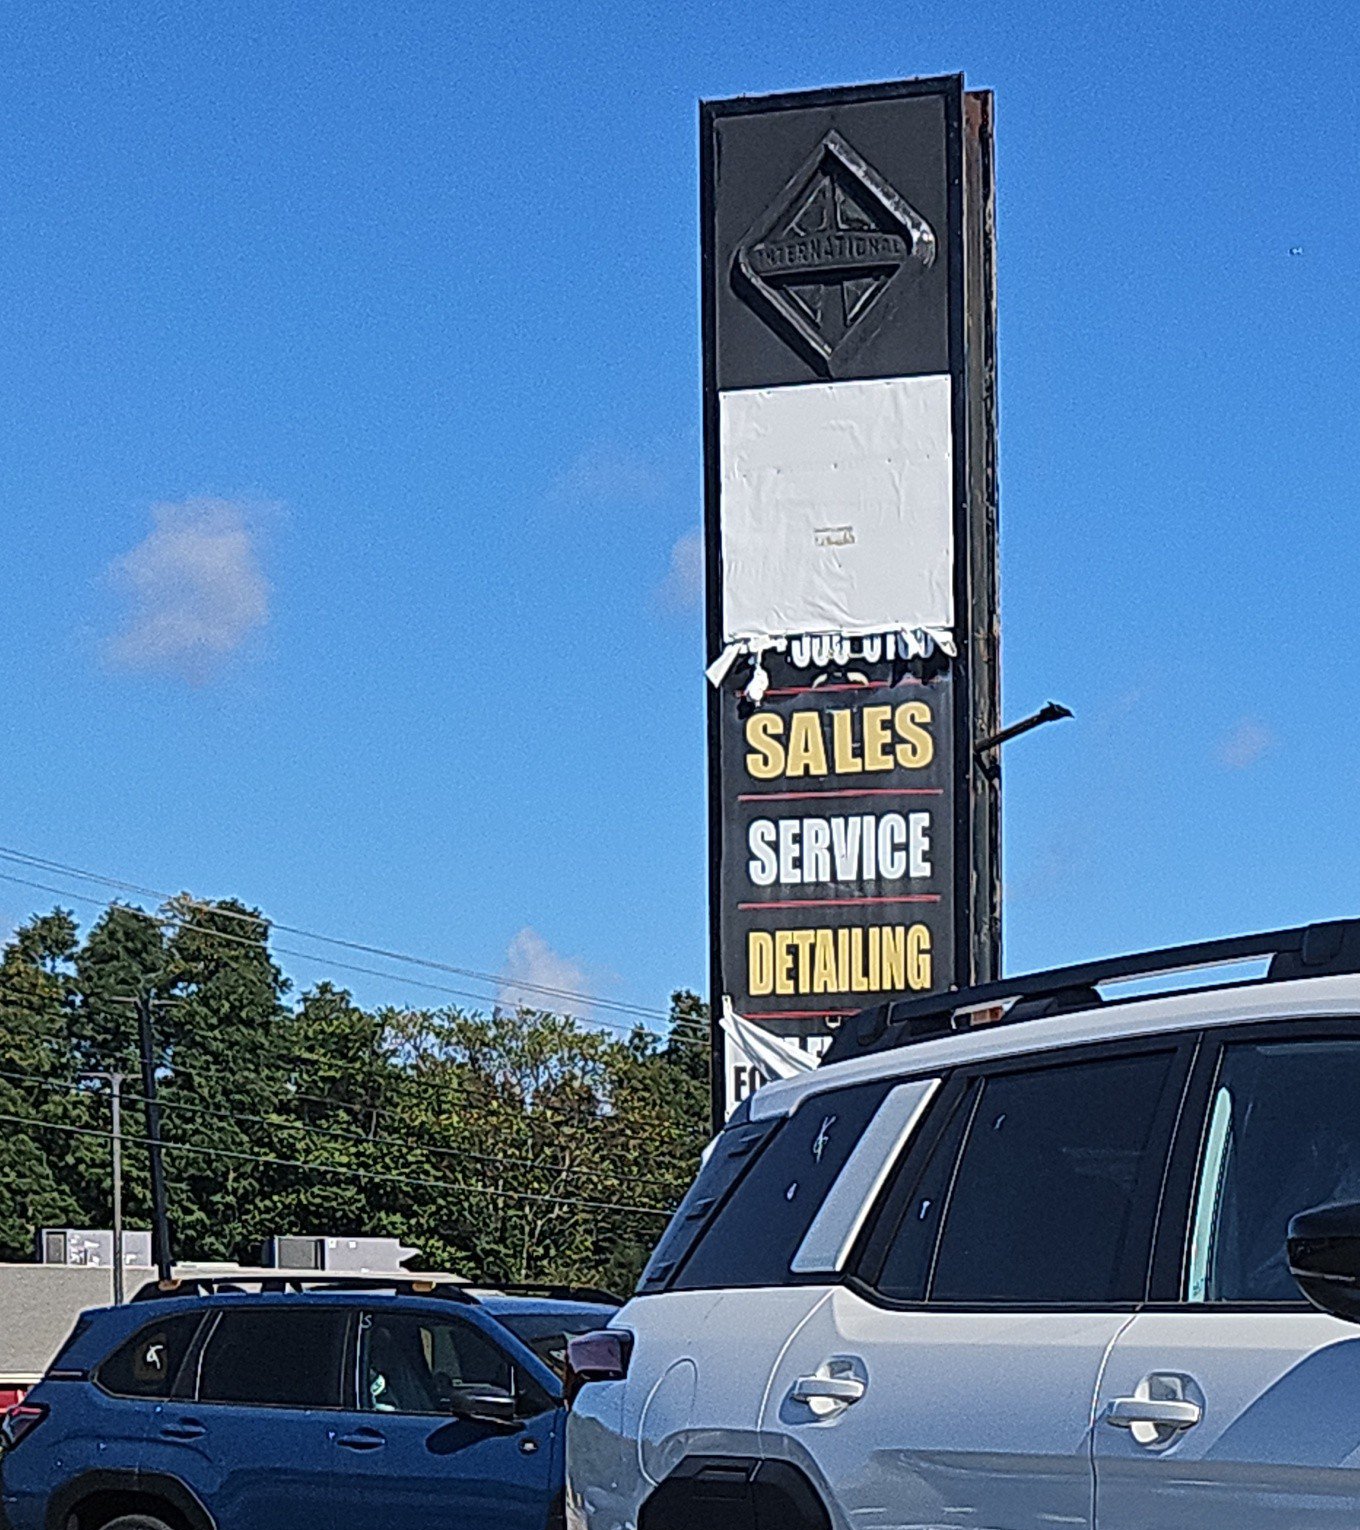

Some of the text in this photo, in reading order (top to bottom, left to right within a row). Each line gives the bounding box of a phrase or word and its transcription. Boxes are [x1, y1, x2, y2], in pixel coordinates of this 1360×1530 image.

[746, 702, 933, 779] SALES
[748, 812, 932, 886] SERVICE
[748, 924, 932, 996] DETAILING
